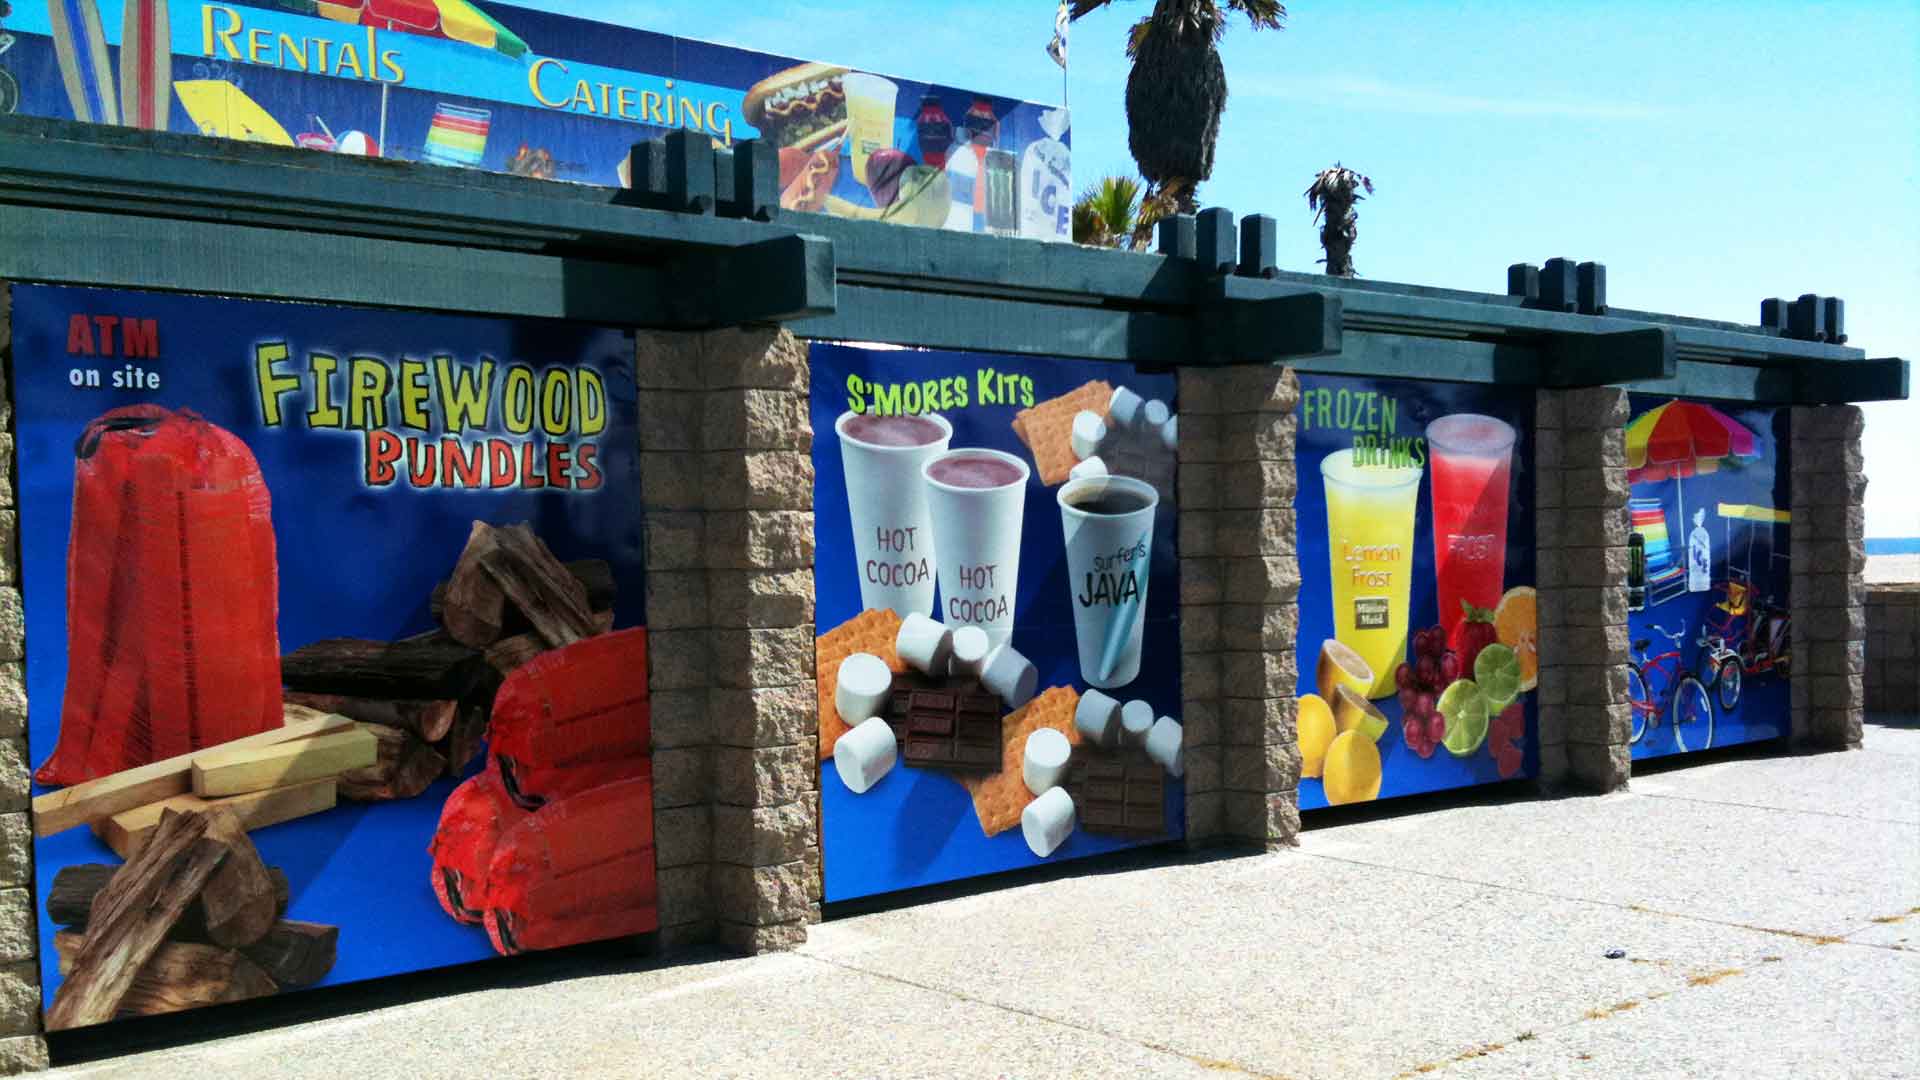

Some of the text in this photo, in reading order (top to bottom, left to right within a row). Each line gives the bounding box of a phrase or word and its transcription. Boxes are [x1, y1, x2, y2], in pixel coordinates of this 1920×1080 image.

[66, 313, 160, 358] ATM
[69, 363, 160, 389] on site
[254, 341, 607, 437] FIREWOOD
[846, 367, 1035, 416] S'MORES KITS
[1303, 387, 1397, 435] FROZEN
[364, 430, 605, 490] BUNDLES
[876, 526, 918, 552] HOT
[866, 557, 931, 588] COCOA
[959, 564, 998, 590] HOT
[1078, 570, 1140, 608] JAVA
[949, 594, 1009, 624] COCOA
